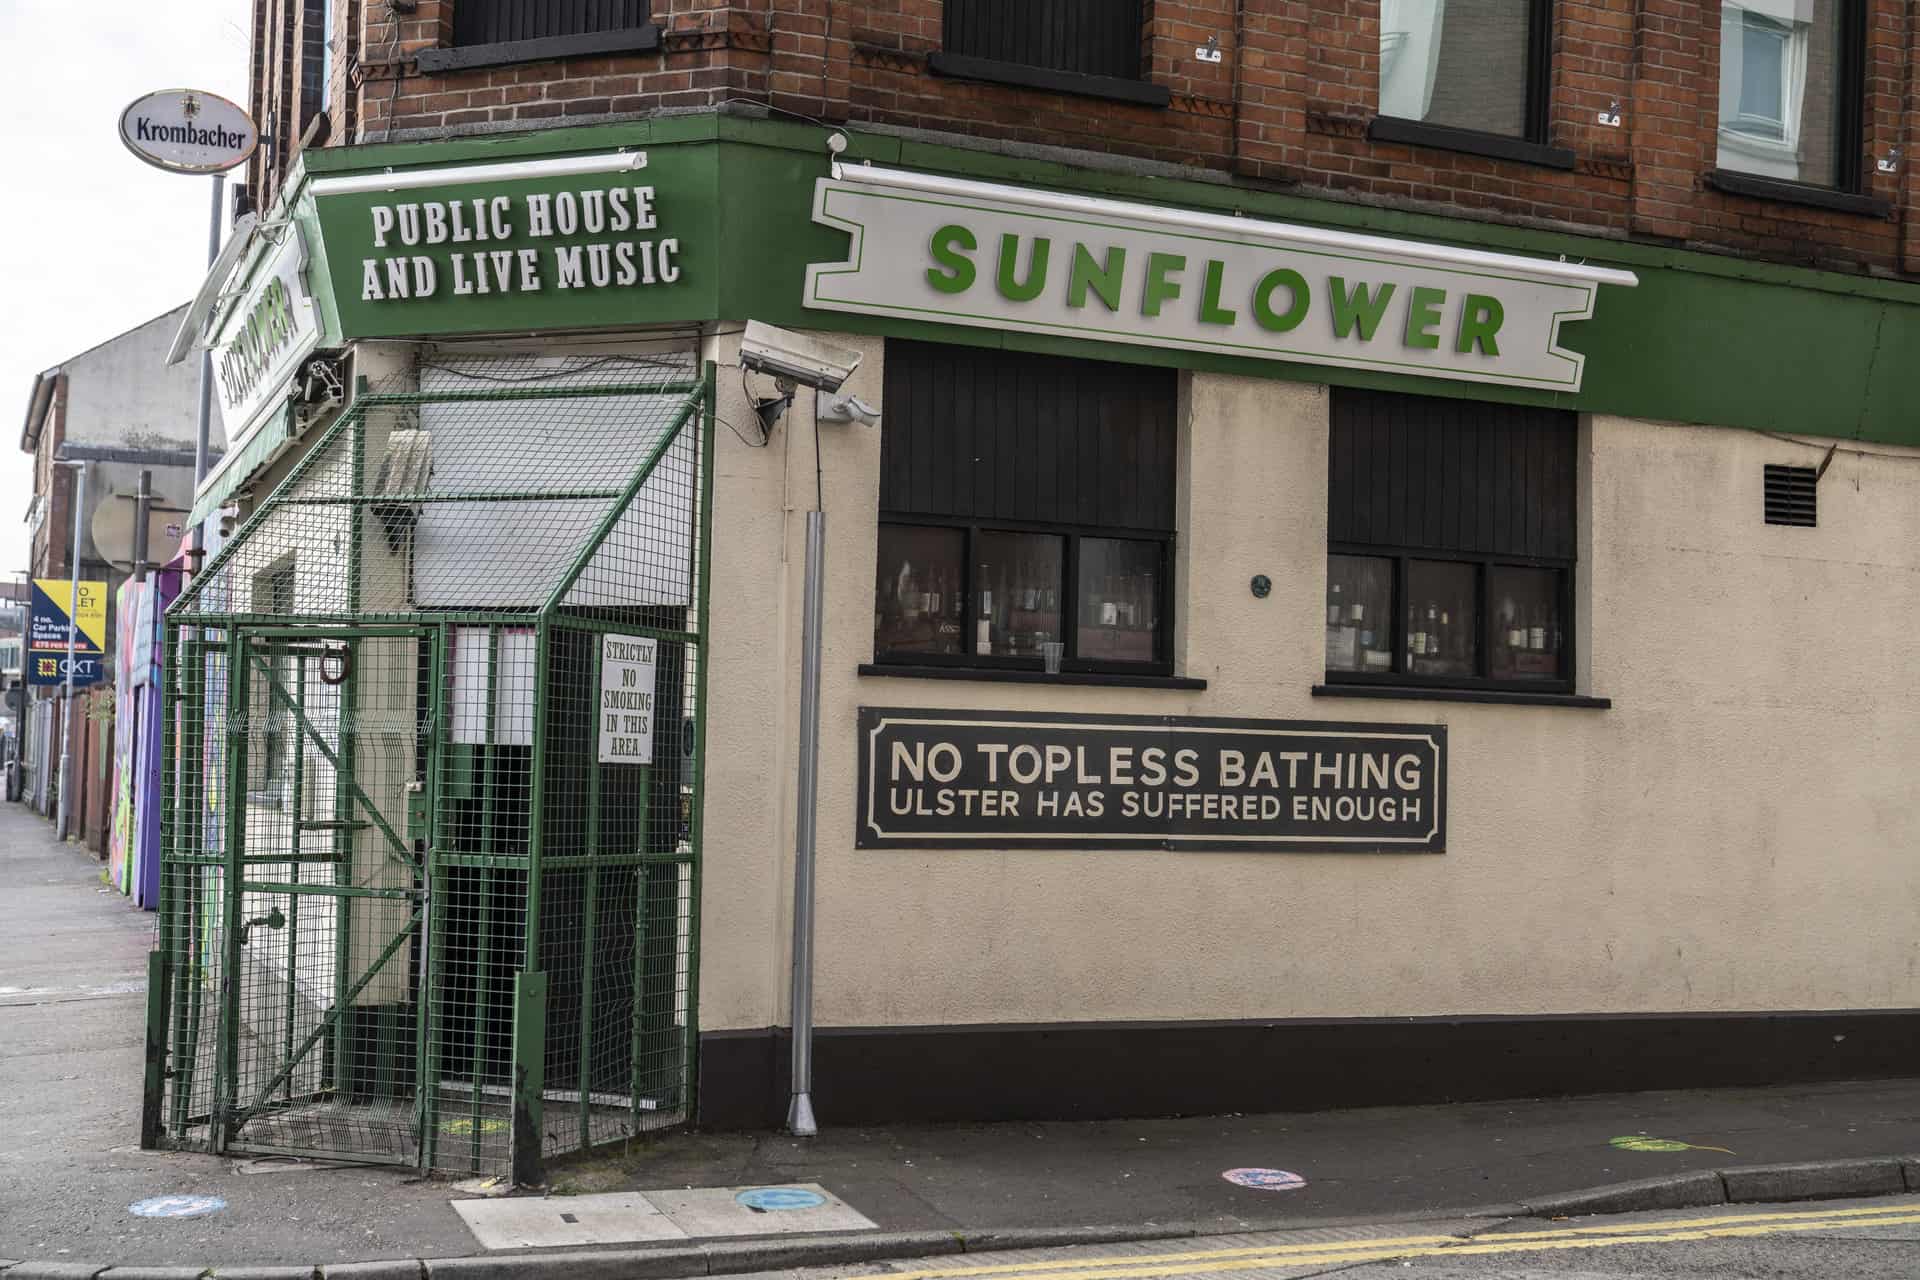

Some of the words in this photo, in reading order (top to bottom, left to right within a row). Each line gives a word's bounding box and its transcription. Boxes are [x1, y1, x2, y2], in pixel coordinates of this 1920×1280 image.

[136, 117, 247, 150] Krombacher
[371, 196, 512, 248] PUBLIC
[526, 186, 658, 237] HOUSE
[361, 255, 438, 301] AND
[450, 249, 542, 295] LIVE
[555, 238, 681, 289] MUSIC
[926, 224, 1506, 357] SUNFLOWER
[33, 632, 62, 640] Spaces
[49, 624, 78, 633] Parkig
[606, 641, 654, 664] STRICTLY
[622, 668, 636, 687] NO
[604, 690, 652, 712] SMOKING
[606, 714, 618, 733] IN
[624, 716, 648, 735] THIS
[611, 737, 642, 757] AREA.
[890, 741, 963, 784] NO
[977, 742, 1200, 788] TOPLESS
[1220, 750, 1423, 791] BATHING
[890, 789, 1020, 818] ULSTER
[1037, 791, 1105, 819] HAS
[1121, 793, 1282, 822] SUFFERED
[1291, 795, 1423, 824] ENOUGH
